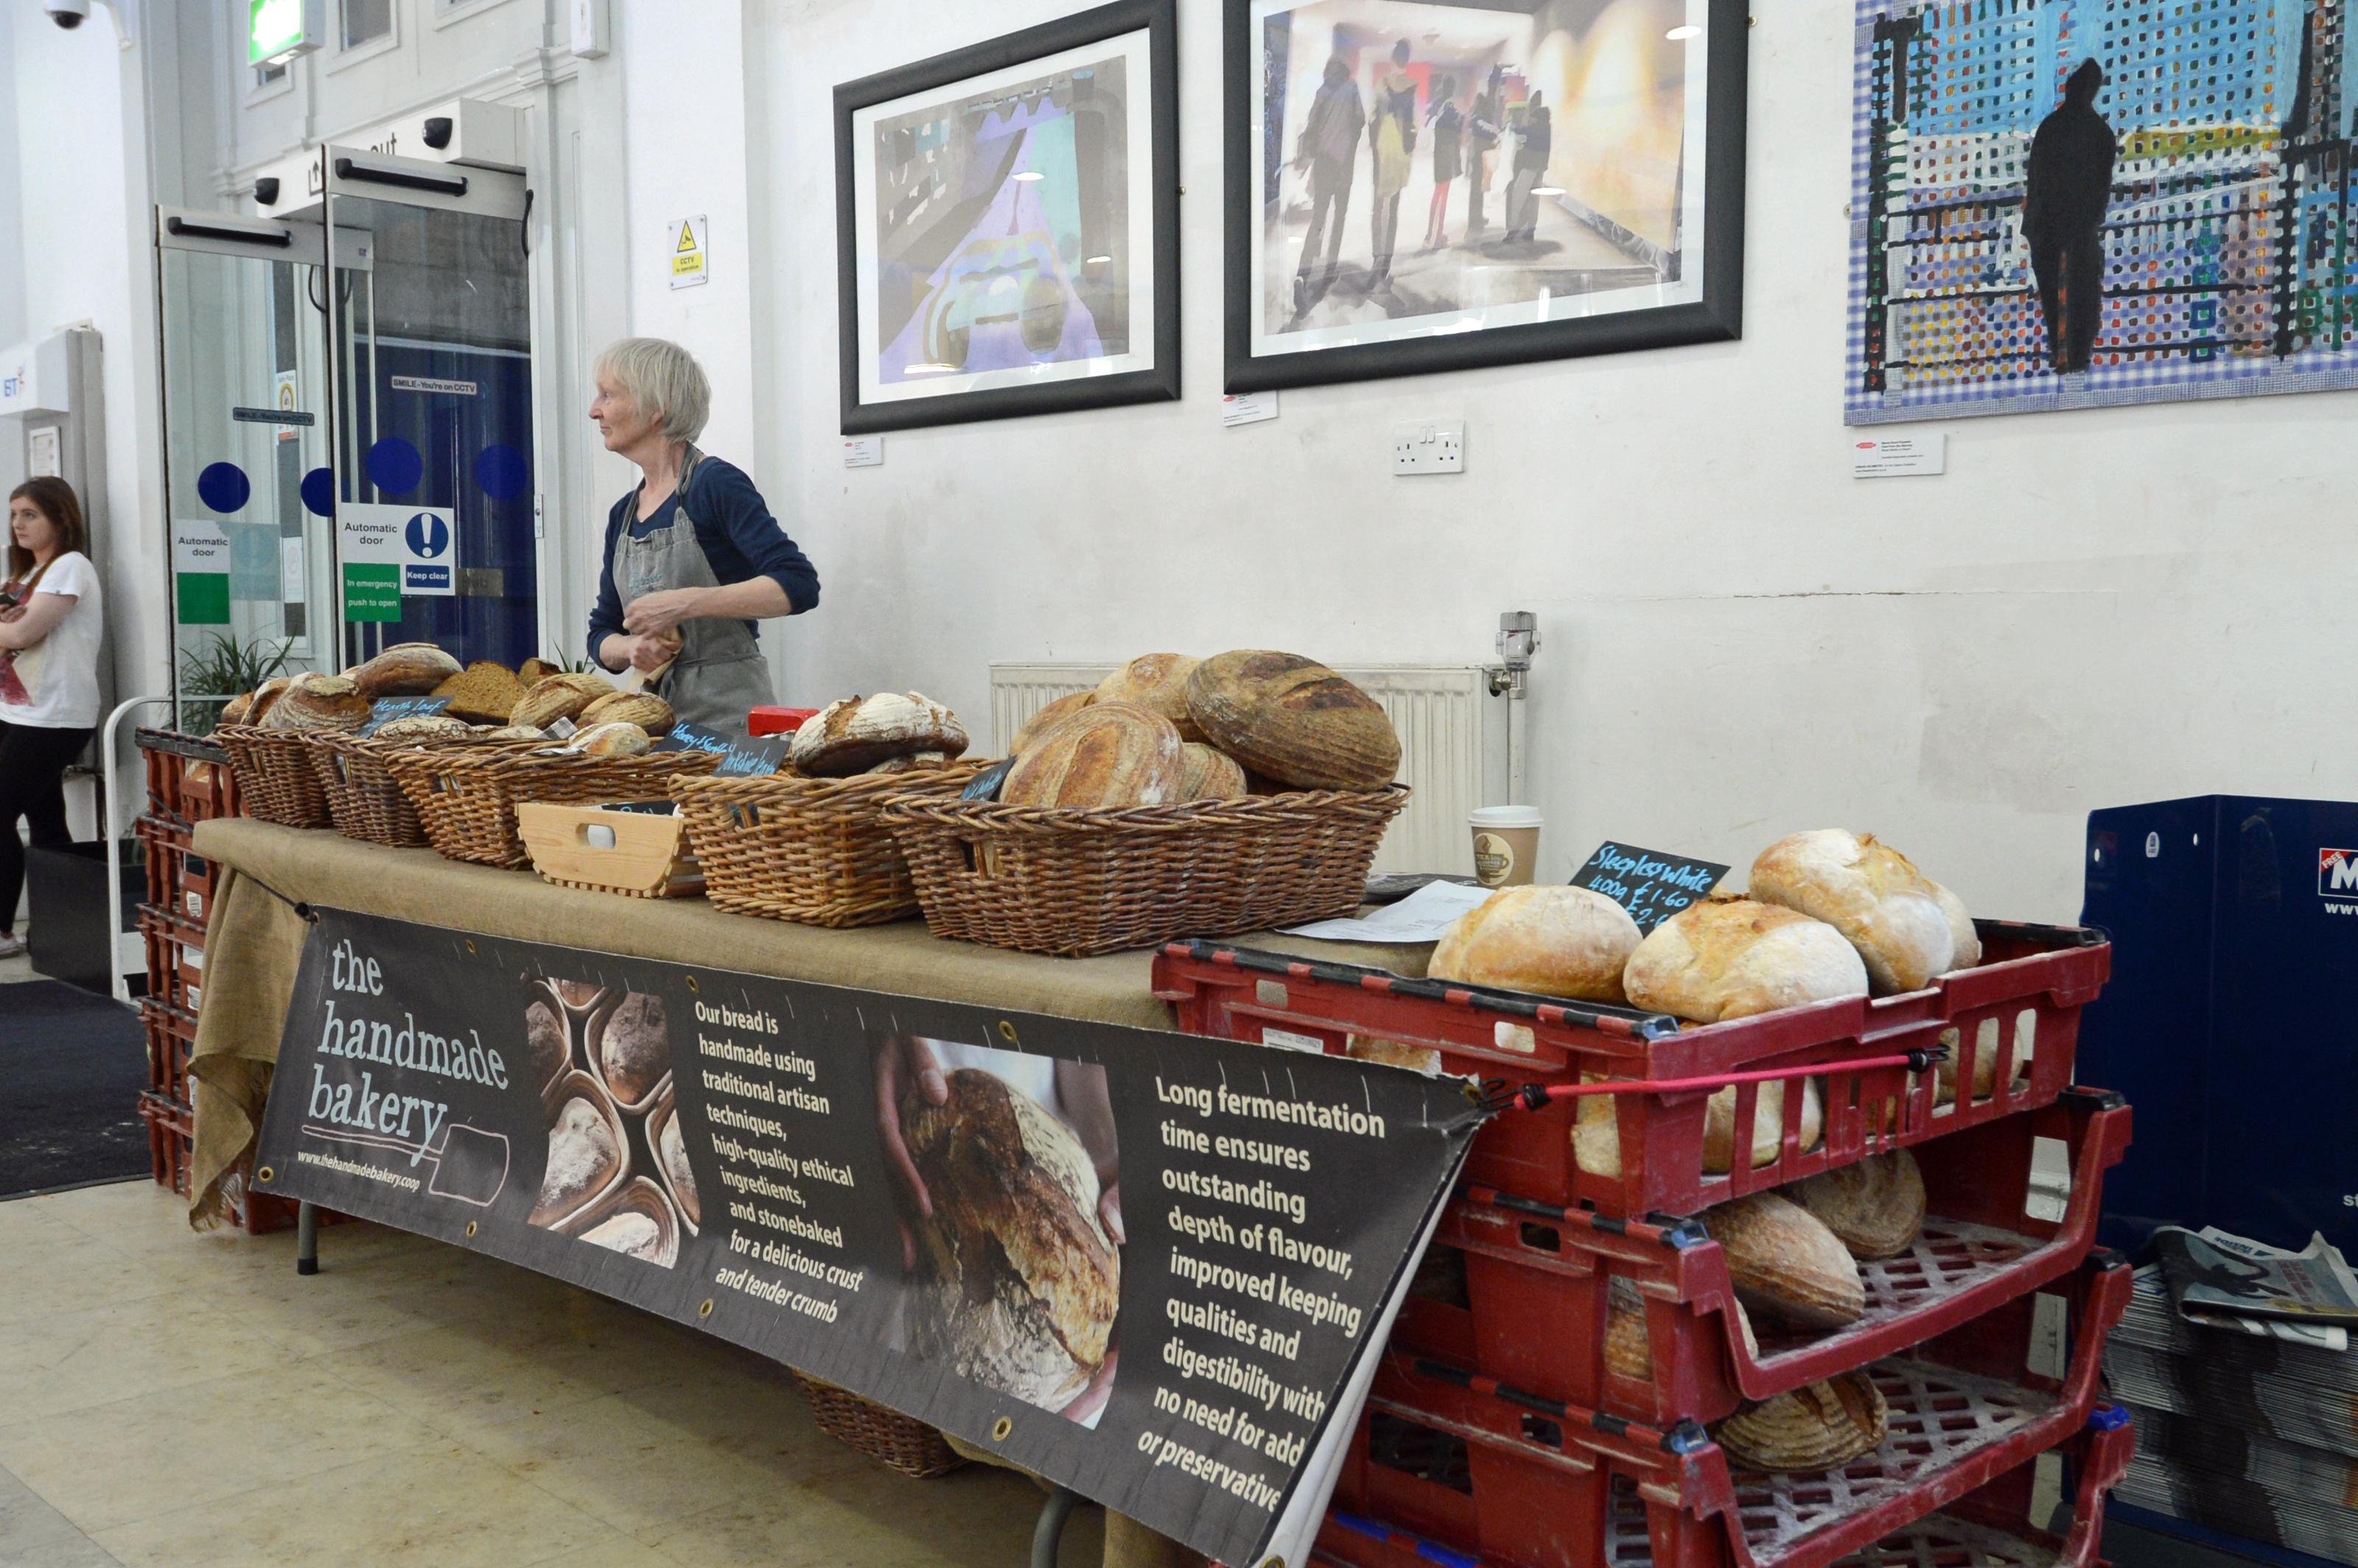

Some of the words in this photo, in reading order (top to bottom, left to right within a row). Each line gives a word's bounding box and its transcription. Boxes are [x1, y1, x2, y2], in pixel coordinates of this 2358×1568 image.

[680, 256, 695, 265] CCTV
[393, 379, 417, 388] SMILE
[454, 384, 475, 392] CCTV
[178, 536, 228, 546] Automatic
[344, 522, 398, 533] Automatic
[360, 536, 384, 545] door
[192, 548, 215, 556] door
[347, 579, 354, 587] In
[356, 580, 398, 589] emergency
[407, 572, 427, 581] Keep
[429, 572, 448, 580] clear
[348, 599, 368, 607] push
[374, 699, 412, 712] Hearth
[412, 699, 446, 713] Loaf
[671, 724, 699, 752] Honey
[1659, 864, 1713, 893] White
[2321, 851, 2344, 869] FREE
[1588, 874, 1629, 903] 400g
[332, 939, 384, 995] the
[695, 1001, 720, 1025] Our
[722, 1004, 763, 1033] bread
[766, 1014, 779, 1035] is
[318, 1001, 508, 1090] handmade
[699, 1033, 772, 1068] handmade
[774, 1050, 816, 1082] using
[702, 1069, 774, 1103] traditional
[777, 1085, 830, 1115] artisan
[1155, 1076, 1213, 1118] Long
[1217, 1084, 1385, 1138] fermentation
[308, 1063, 448, 1168] bakery
[706, 1103, 788, 1141] techniques,
[711, 1133, 798, 1177] high-quality
[802, 1158, 855, 1188] ethical
[1161, 1119, 1210, 1154] time
[1215, 1135, 1312, 1172] ensures
[298, 1151, 420, 1193] www.thehandmadebakery.coop
[720, 1166, 806, 1208] ingredients,
[1162, 1169, 1306, 1225] outstanding
[730, 1200, 756, 1223] and
[759, 1207, 843, 1249] stonebaked
[1168, 1205, 1235, 1245] depth
[1240, 1223, 1264, 1253] of
[1268, 1226, 1354, 1281] flavour,
[730, 1228, 750, 1256] for
[752, 1239, 760, 1259] a
[763, 1240, 825, 1280] delicious
[826, 1263, 864, 1292] crust
[716, 1265, 744, 1290] and
[745, 1271, 792, 1307] tender
[791, 1289, 839, 1324] crumb
[1170, 1246, 1276, 1303] improved
[1278, 1275, 1362, 1339] keeping
[1166, 1298, 1258, 1346] qualities
[1259, 1328, 1301, 1361] and
[1163, 1337, 1282, 1411] digestibility
[1283, 1385, 1326, 1423] with
[1153, 1386, 1181, 1414] no
[1183, 1397, 1236, 1438] need
[1232, 1413, 1265, 1450] for
[1138, 1431, 1164, 1455] or
